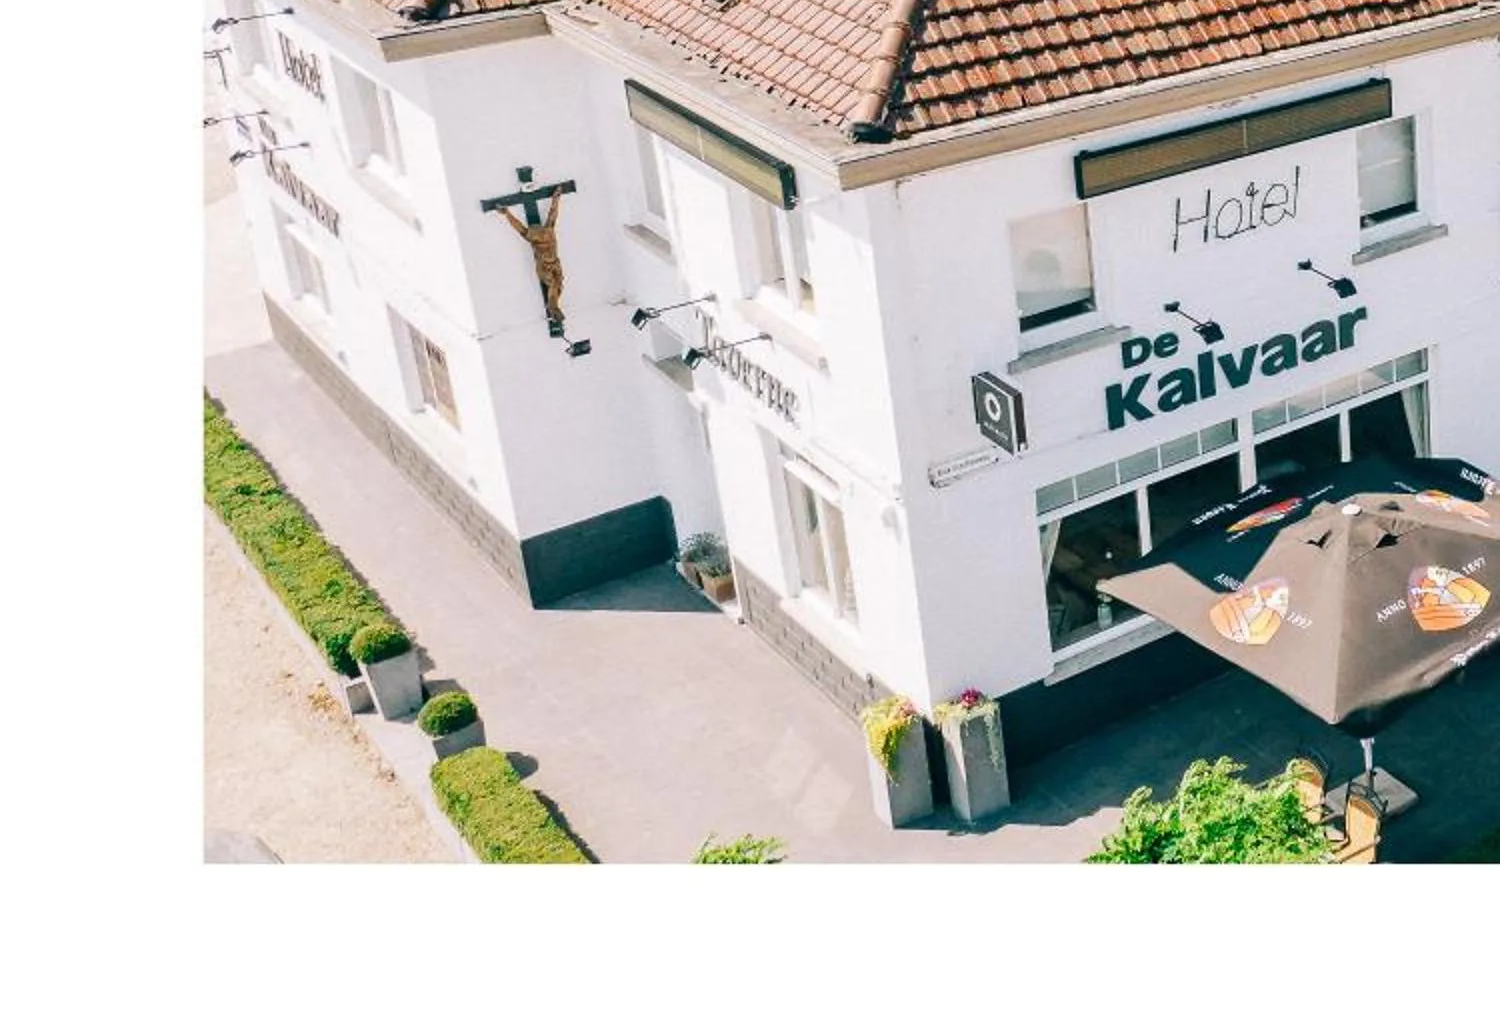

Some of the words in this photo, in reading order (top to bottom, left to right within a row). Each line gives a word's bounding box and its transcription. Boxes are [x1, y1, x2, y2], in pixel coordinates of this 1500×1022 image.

[1173, 165, 1300, 253] Hotel
[1104, 306, 1368, 432] Kalvaar
[1120, 331, 1180, 370] De
[1375, 598, 1408, 624] ANNO
[1460, 555, 1488, 575] 1897
